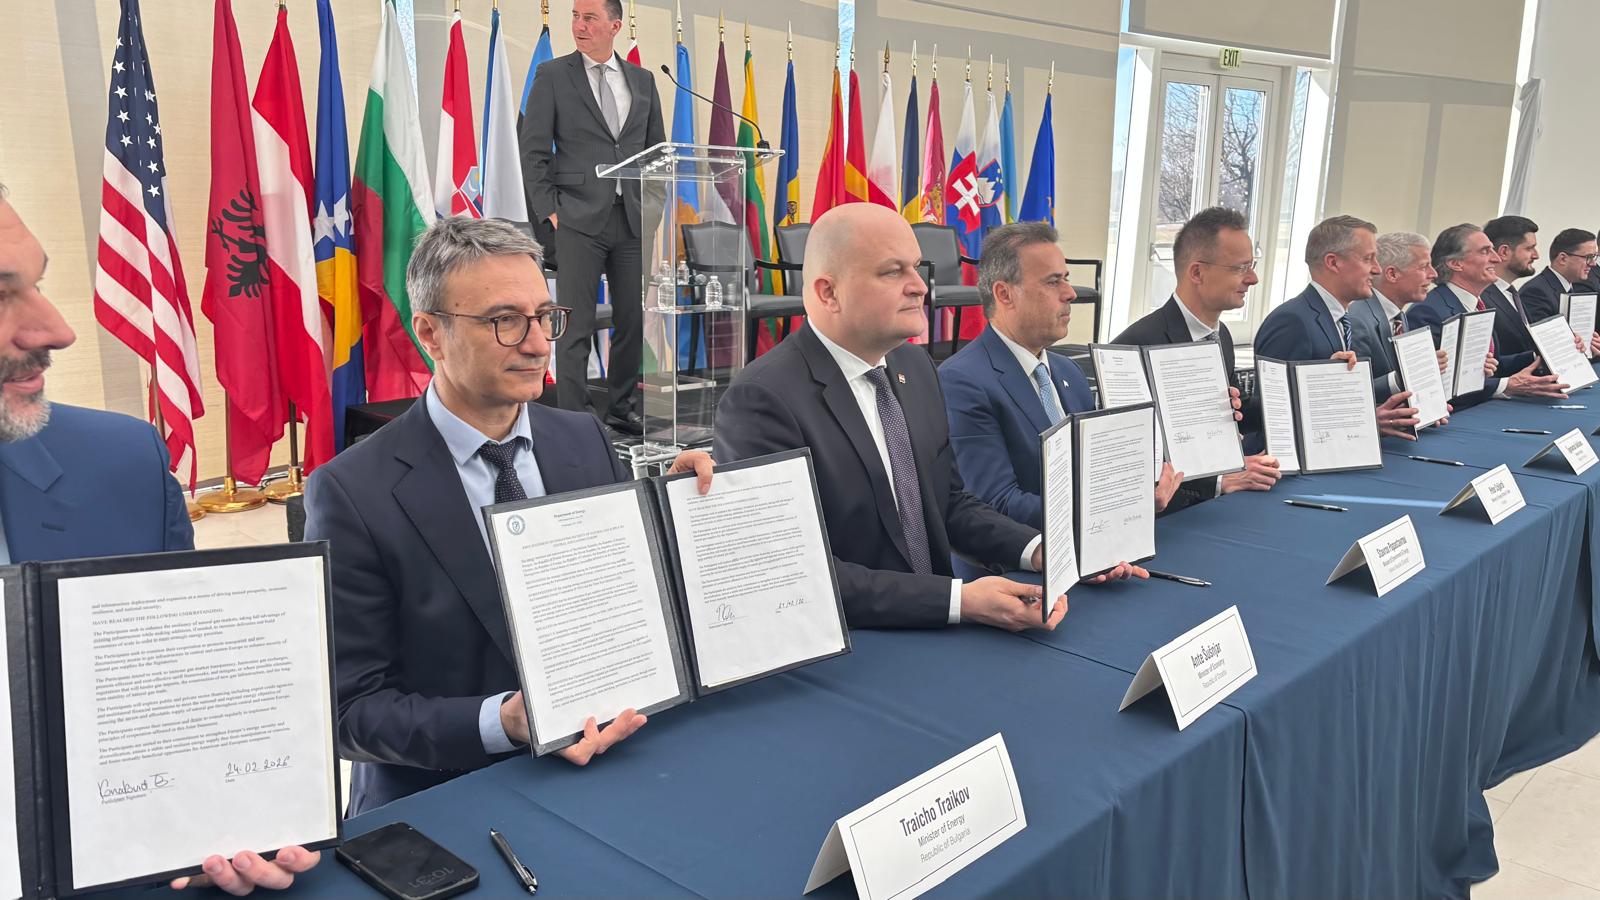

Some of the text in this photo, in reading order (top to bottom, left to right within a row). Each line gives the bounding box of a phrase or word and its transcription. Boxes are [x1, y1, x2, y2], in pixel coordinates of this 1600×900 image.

[1224, 48, 1239, 67] EXIT
[899, 786, 970, 836] Traicho Traikov
[918, 814, 966, 848] Minister of Energy
[920, 828, 971, 863] Republic of Bulgaria
